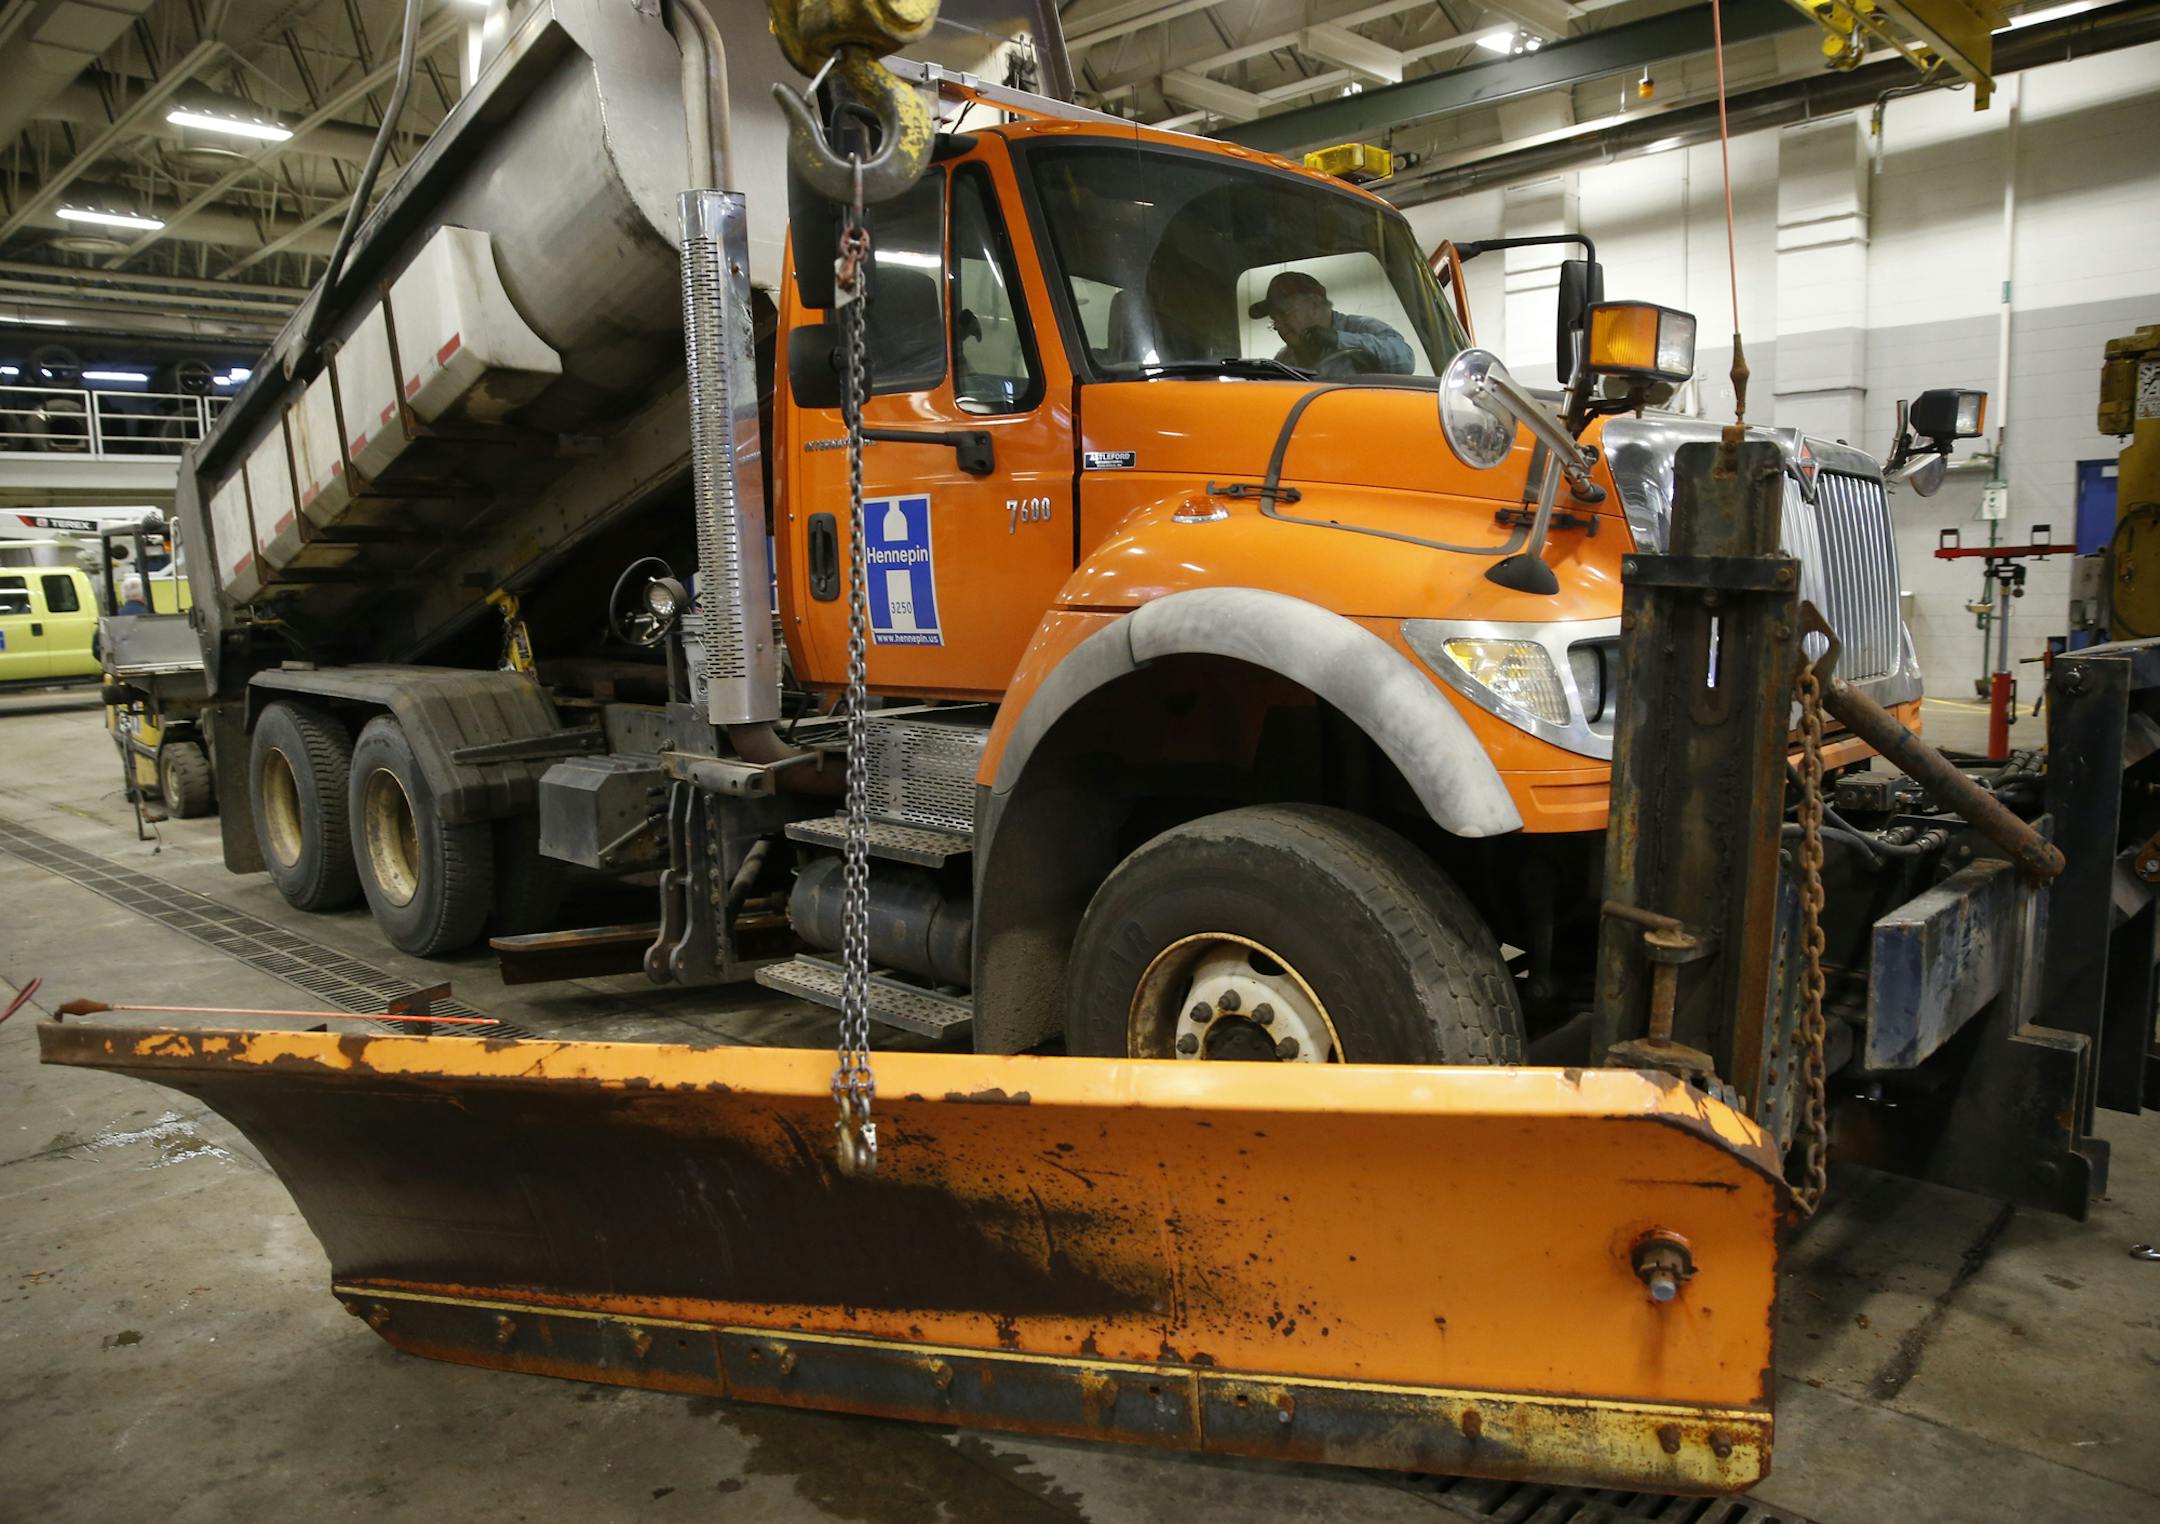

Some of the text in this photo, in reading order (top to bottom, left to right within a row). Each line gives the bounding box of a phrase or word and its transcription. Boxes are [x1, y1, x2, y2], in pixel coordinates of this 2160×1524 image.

[1006, 497, 1050, 535] 7600
[51, 519, 91, 530] TEREX
[866, 545, 929, 566] Hennepin
[890, 601, 912, 615] 3250
[876, 634, 939, 645] www.hennepin.us
